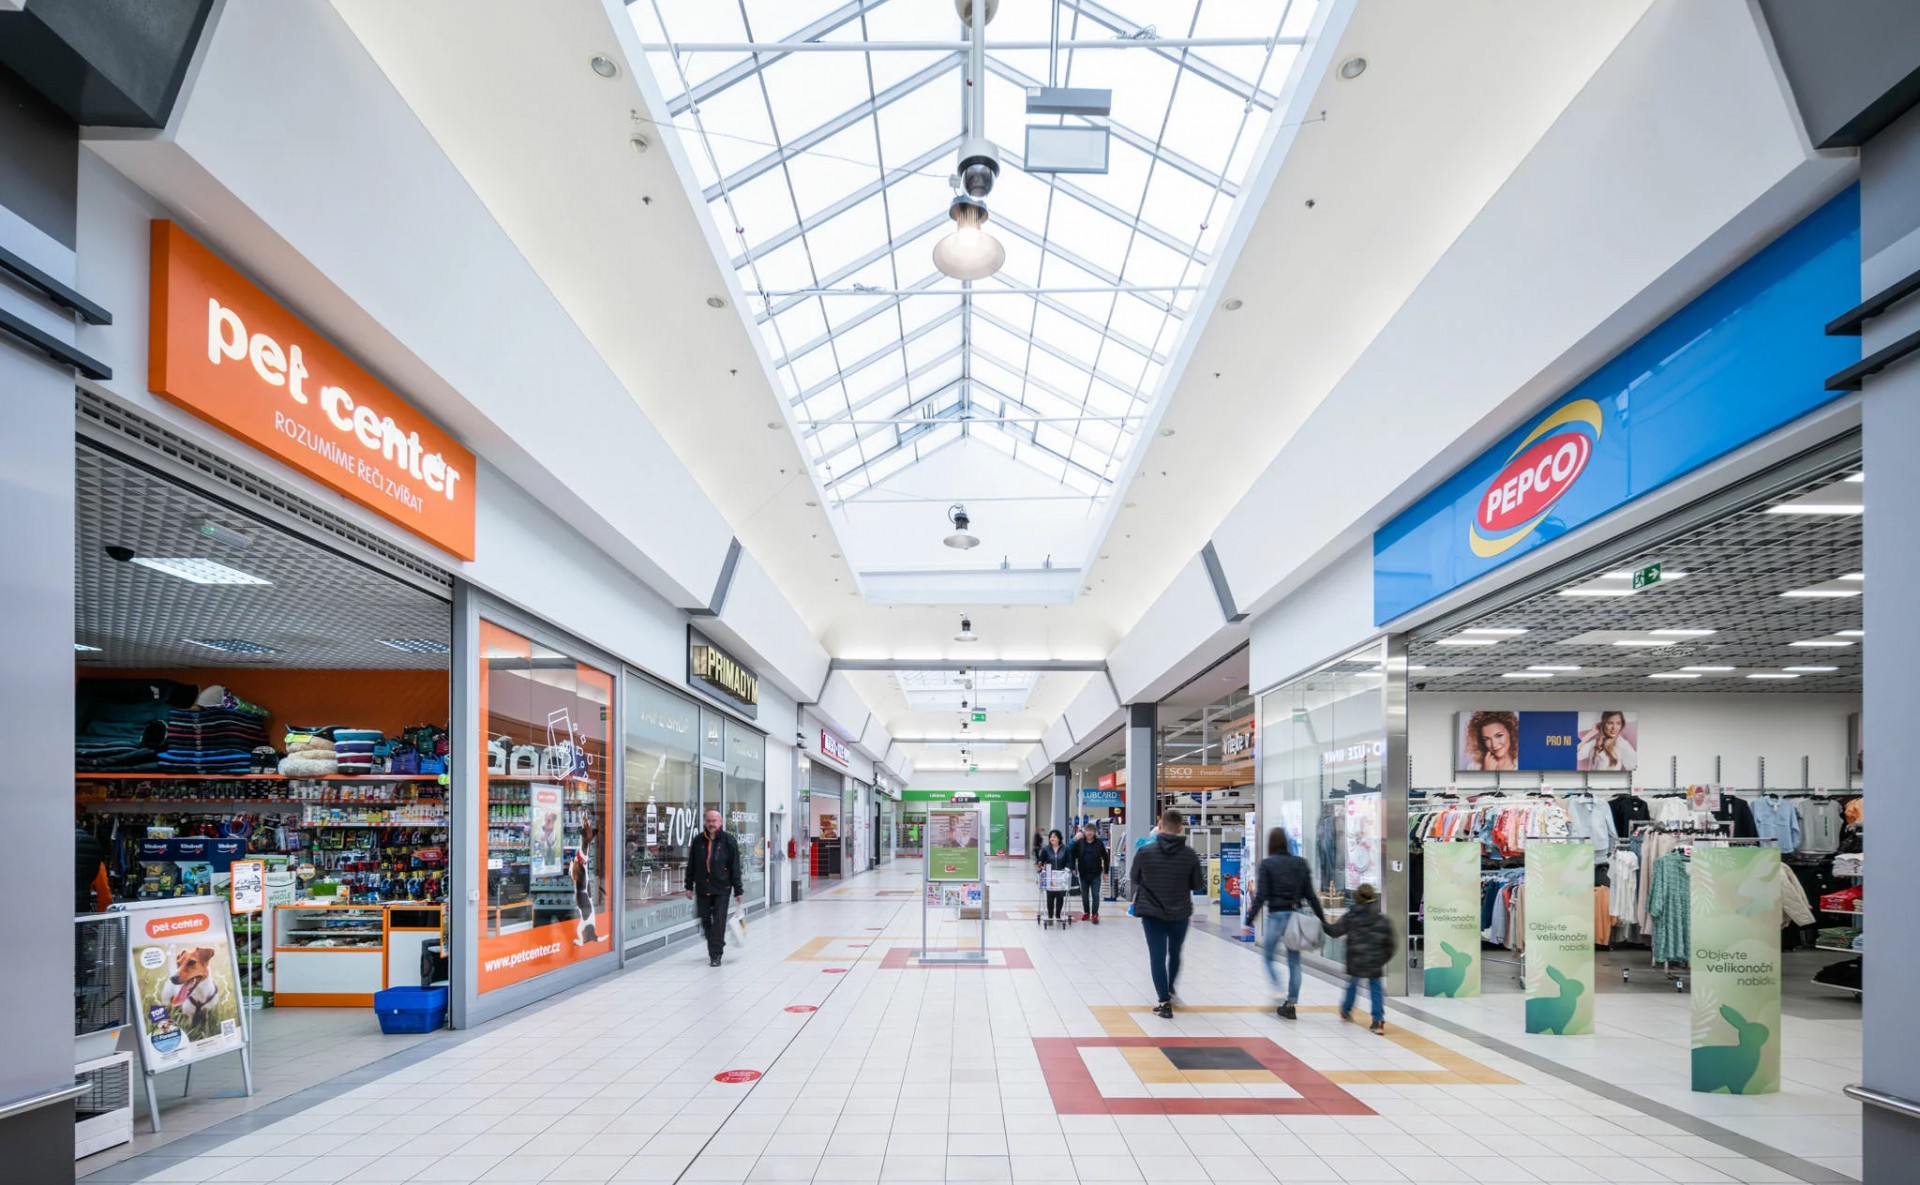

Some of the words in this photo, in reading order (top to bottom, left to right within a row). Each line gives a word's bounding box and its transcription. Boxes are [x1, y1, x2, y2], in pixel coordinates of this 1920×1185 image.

[207, 297, 309, 405] pet
[321, 386, 460, 500] center
[275, 410, 355, 475] ROZUMÍME
[357, 457, 384, 490] ŘEČI
[386, 477, 424, 513] ZVÍŘAT
[1486, 441, 1578, 524] PEPCO
[706, 645, 758, 705] PRIMADYM
[1546, 735, 1562, 746] PRO
[1563, 735, 1572, 746] NI
[152, 924, 171, 935] pet
[171, 919, 204, 931] center
[1529, 922, 1568, 933] Objevte
[1536, 932, 1588, 942] velikonoční
[484, 942, 561, 972] www.petcenter.cz
[1695, 949, 1748, 961] Objevte
[1706, 962, 1774, 973] velikonoční
[151, 1006, 165, 1018] TOP
